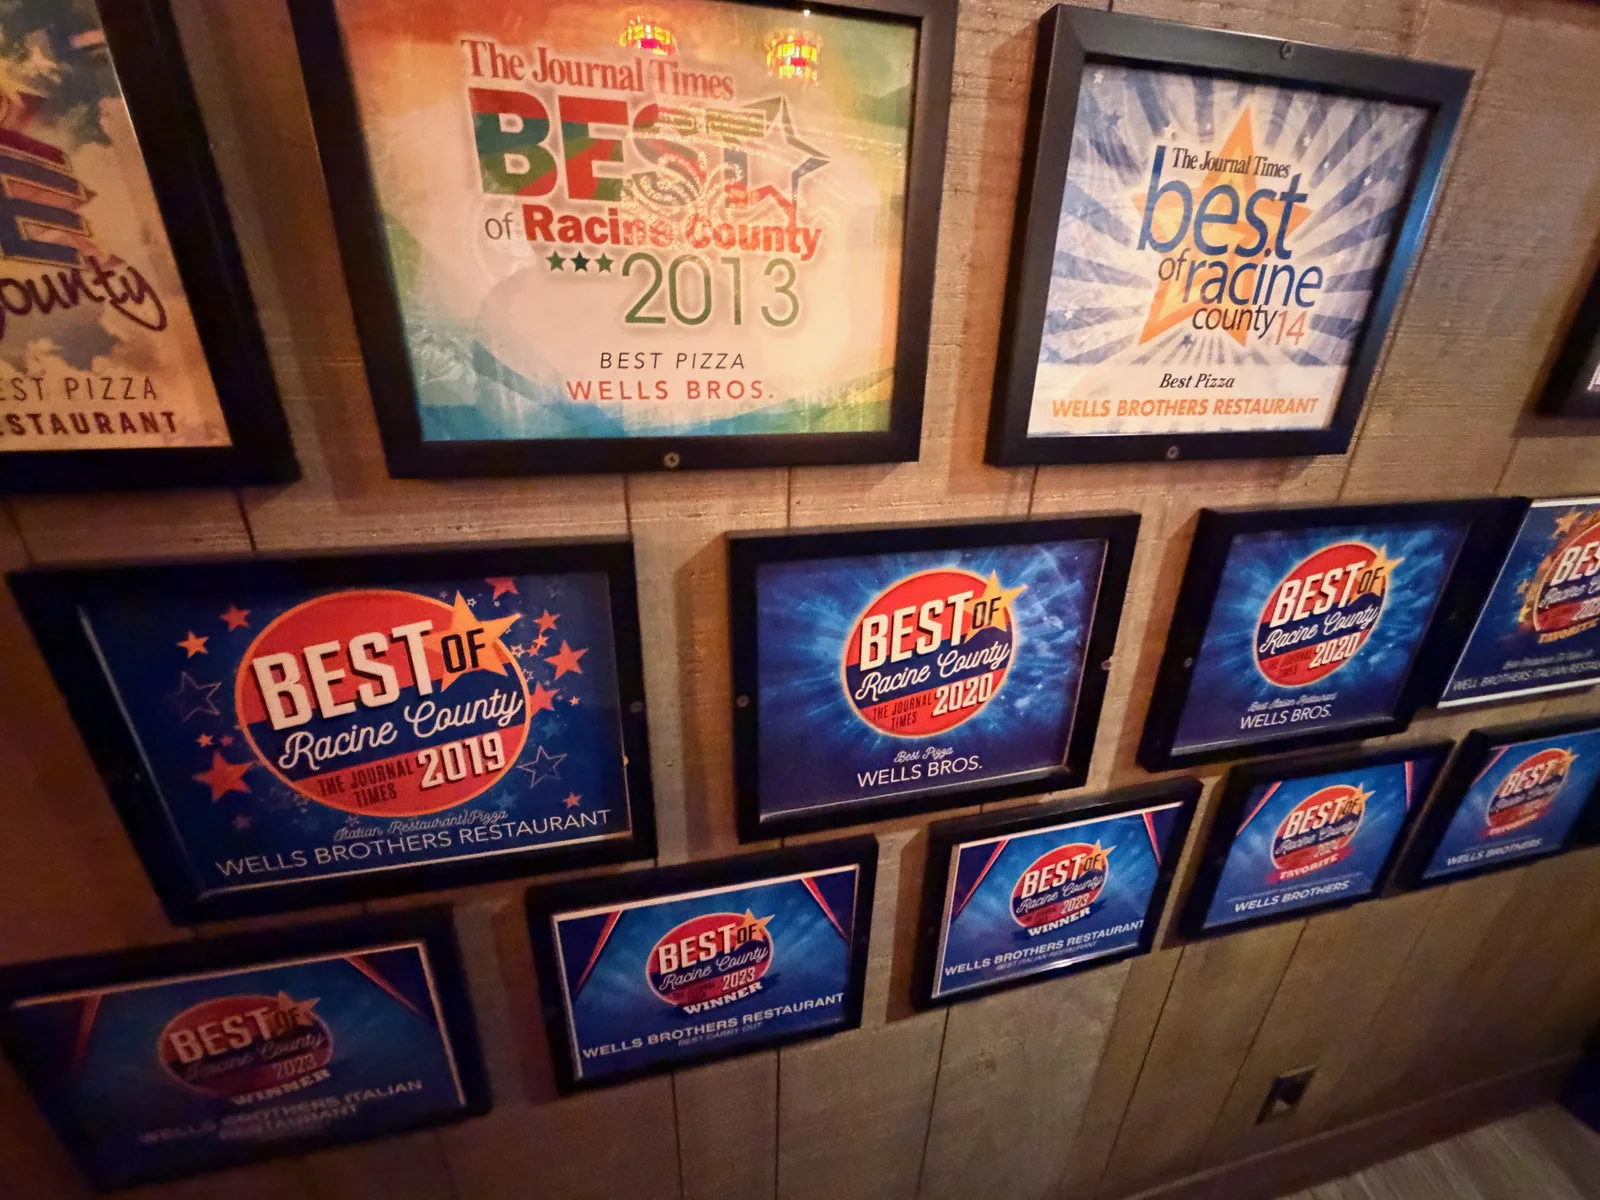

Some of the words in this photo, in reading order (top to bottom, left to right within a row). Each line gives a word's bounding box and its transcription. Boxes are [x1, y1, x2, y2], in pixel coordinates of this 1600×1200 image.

[460, 39, 525, 80] The
[532, 47, 646, 94] Journal
[650, 59, 735, 100] Times
[468, 86, 768, 210] BEST
[1171, 147, 1199, 170] The
[1199, 150, 1250, 175] Journal
[1252, 156, 1292, 180] Times
[1136, 145, 1308, 260] best
[485, 212, 514, 241] of
[522, 204, 676, 248] Racine
[686, 214, 823, 261] County
[0, 252, 168, 332] ounty
[622, 252, 800, 327] 2013
[1158, 248, 1190, 283] of
[1182, 250, 1324, 308] racine
[600, 352, 663, 371] BEST
[676, 352, 746, 371] PIZZA
[1158, 373, 1193, 389] Best
[1194, 373, 1236, 389] Pizza
[0, 376, 44, 402] ST
[64, 375, 158, 401] PIZZA
[566, 380, 669, 401] WELLS
[687, 380, 775, 401] BROS.
[1051, 399, 1111, 417] WELLS
[1116, 398, 1209, 418] BROTHERS
[1212, 397, 1319, 416] RESTAURANT
[0, 410, 178, 437] STAURANT
[1269, 560, 1368, 629] BEST
[1358, 566, 1385, 596] OF
[860, 590, 975, 672] BEST
[971, 596, 1003, 630] OF
[1259, 623, 1319, 655] Racine
[1322, 604, 1379, 636] County
[1308, 632, 1359, 669] 2020
[252, 620, 434, 732] BEST
[441, 628, 486, 673] OF
[855, 664, 931, 702] Racine
[936, 640, 1011, 676] County
[872, 704, 889, 722] THE
[890, 692, 933, 717] JOURNAL
[932, 672, 994, 717] 2020
[278, 718, 399, 772] Racine
[403, 688, 524, 739] County
[890, 710, 918, 731] TIMES
[1240, 710, 1290, 730] WELLS
[1290, 704, 1332, 723] BROS.
[416, 733, 506, 790] 2019
[857, 764, 922, 788] WELLS
[927, 755, 983, 778] BROS.
[893, 750, 921, 764] Best
[922, 745, 954, 762] Pizza
[317, 776, 346, 798] THE
[350, 761, 414, 790] JOURNAL
[352, 782, 398, 810] TIMES
[333, 826, 384, 843] Italian
[1283, 795, 1350, 841] BEST
[215, 849, 308, 878] WELLS
[314, 829, 453, 865] BROTHERS
[458, 808, 612, 846] RESTAURANT
[1016, 891, 1059, 914] Racine
[1062, 875, 1105, 898] County
[1021, 853, 1088, 899] BEST
[1083, 853, 1101, 874] OF
[1061, 893, 1090, 915] 2023
[1235, 896, 1280, 913] WELLS
[1281, 880, 1351, 904] BROTHERS
[1027, 907, 1092, 937] WINNER
[658, 923, 737, 976] BEST
[735, 922, 758, 945] OF
[944, 957, 992, 977] WELLS
[993, 939, 1065, 965] BROTHERS
[1066, 918, 1145, 947] RESTAURANT
[659, 965, 713, 992] Racine
[714, 945, 769, 973] County
[722, 967, 756, 992] 2023
[682, 981, 763, 1015] WINNER
[168, 1006, 273, 1065] BEST
[582, 1037, 643, 1060] WELLS
[647, 1017, 739, 1046] BROTHERS
[742, 992, 845, 1023] RESTAURANT
[231, 1068, 332, 1106] WINNER
[343, 1079, 424, 1104] ITALIAN
